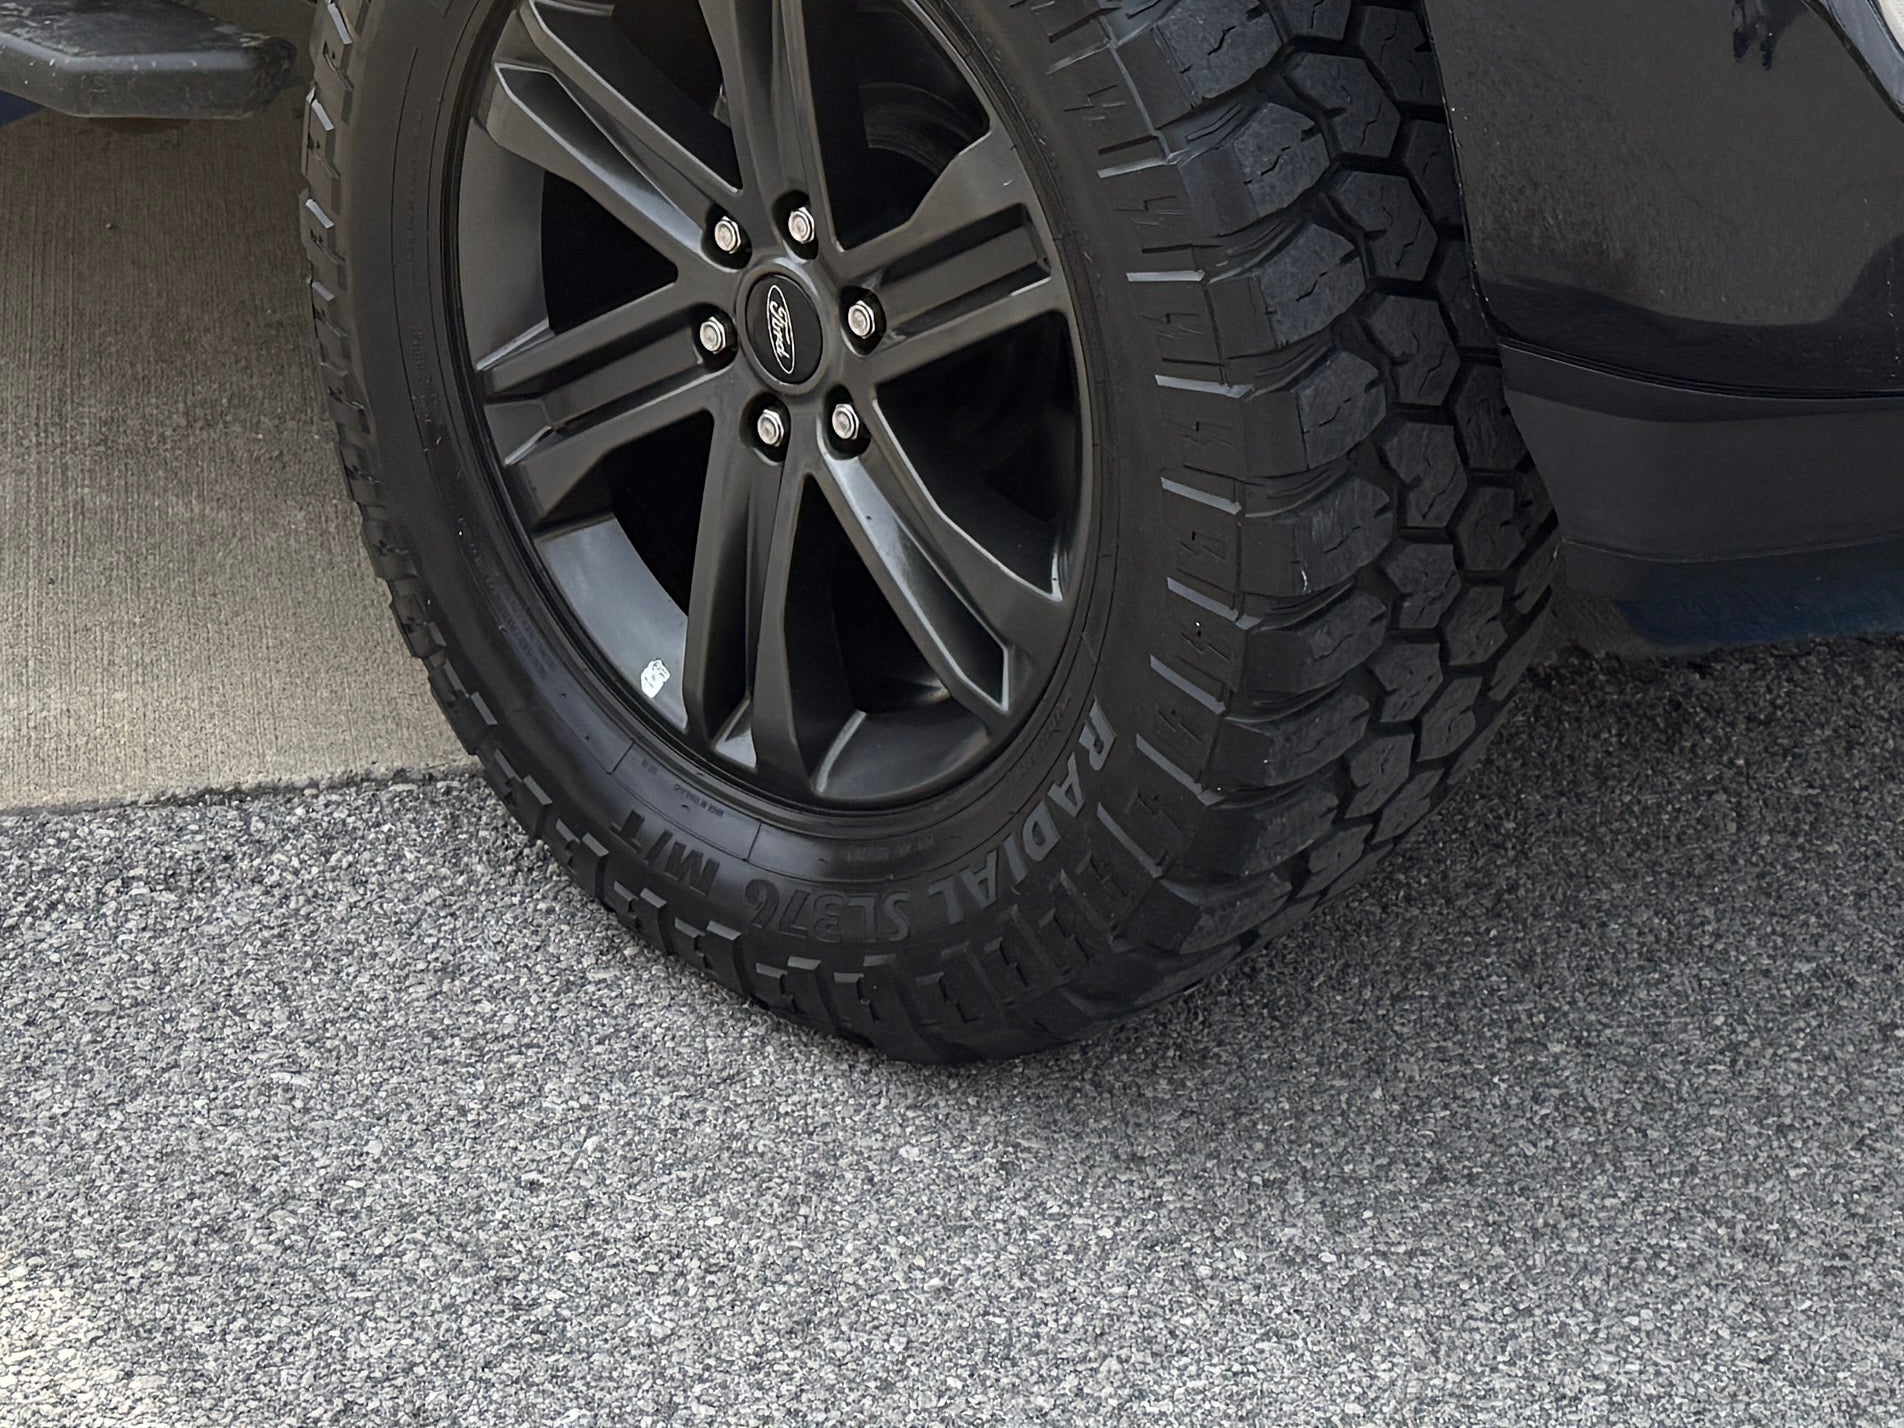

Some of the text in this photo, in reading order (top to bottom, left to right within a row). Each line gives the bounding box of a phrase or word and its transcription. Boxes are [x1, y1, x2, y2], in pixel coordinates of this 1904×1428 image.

[769, 300, 791, 359] Ford
[928, 696, 1118, 925] RADIAL
[610, 809, 721, 896] M/T
[744, 878, 912, 944] SL376
